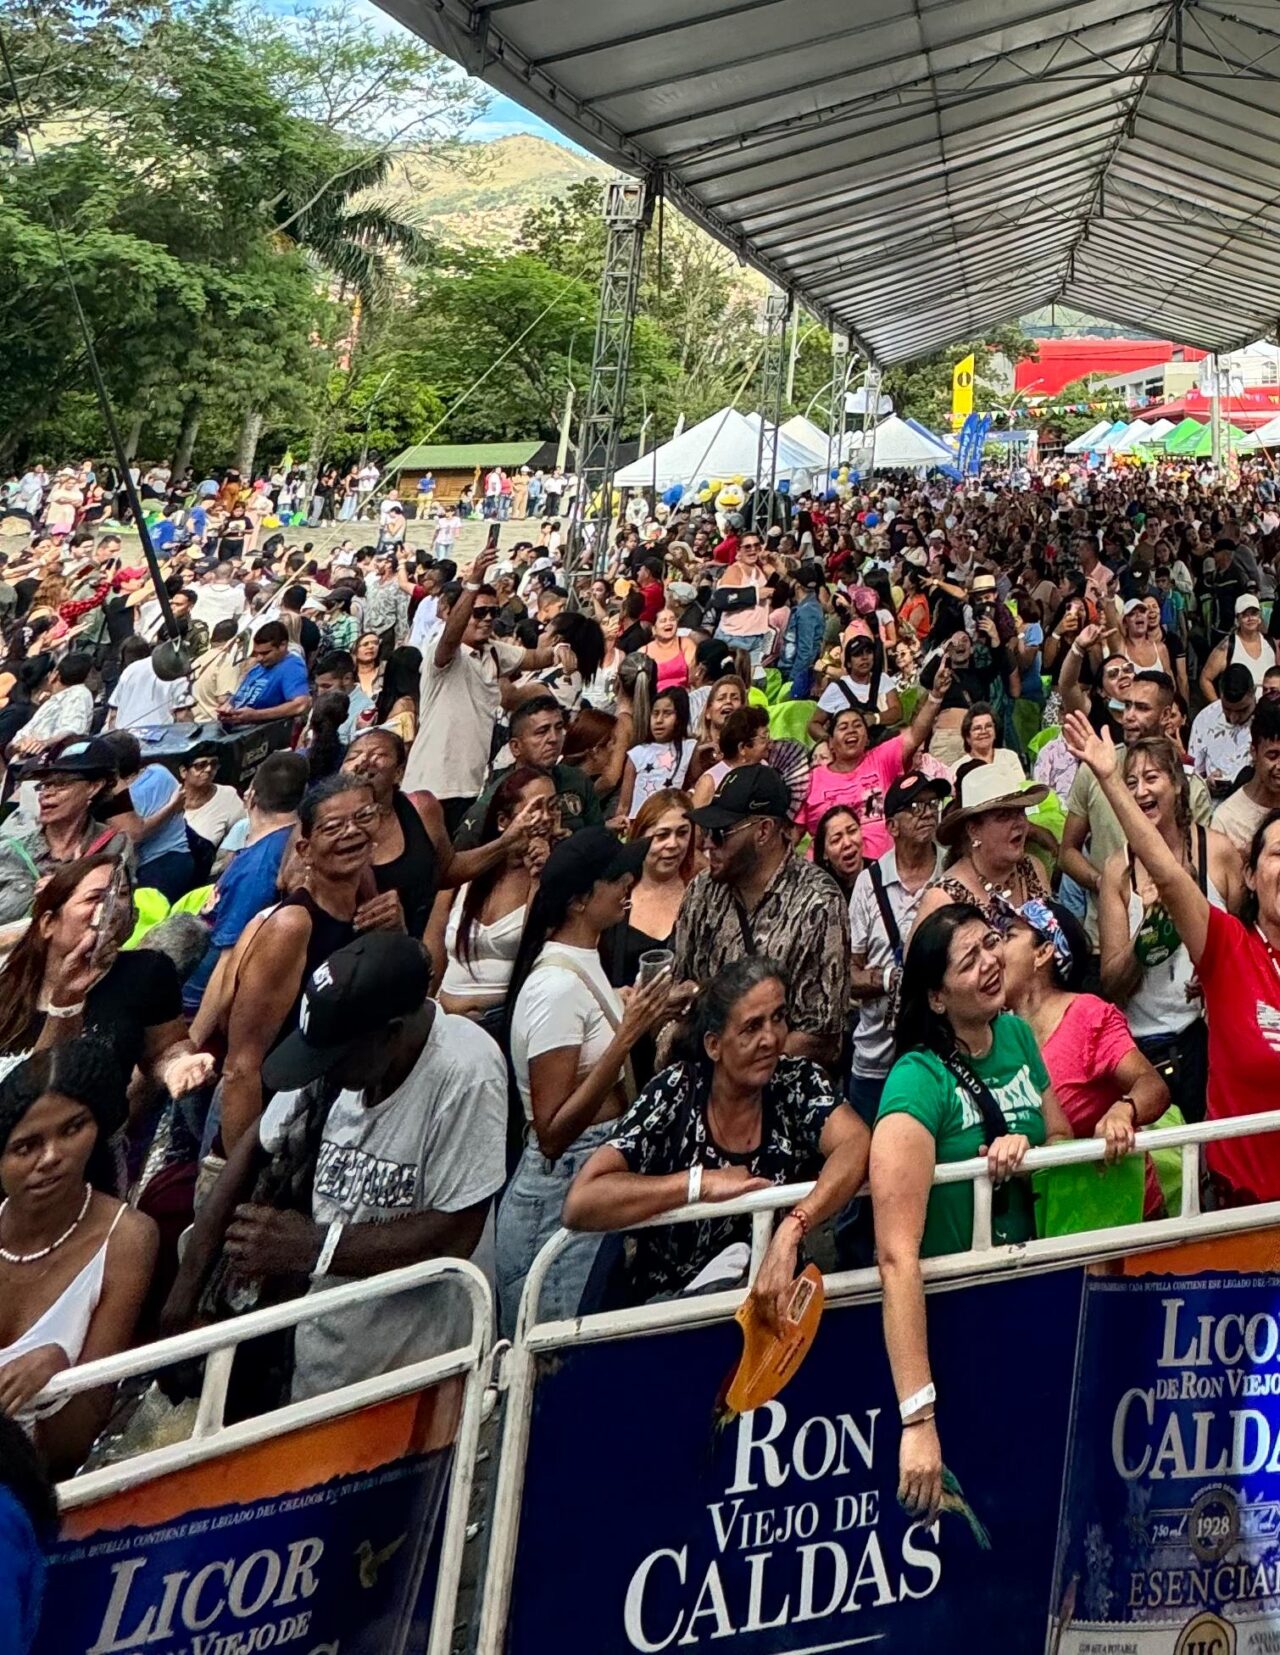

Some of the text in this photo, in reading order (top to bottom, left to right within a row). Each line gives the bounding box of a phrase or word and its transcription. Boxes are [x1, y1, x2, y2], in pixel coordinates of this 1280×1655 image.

[725, 1400, 881, 1495] RON
[706, 1490, 880, 1553] VIEJO DE
[1196, 1515, 1231, 1538] 1928
[86, 1536, 324, 1655] LICOR
[623, 1521, 942, 1653] CALDAS
